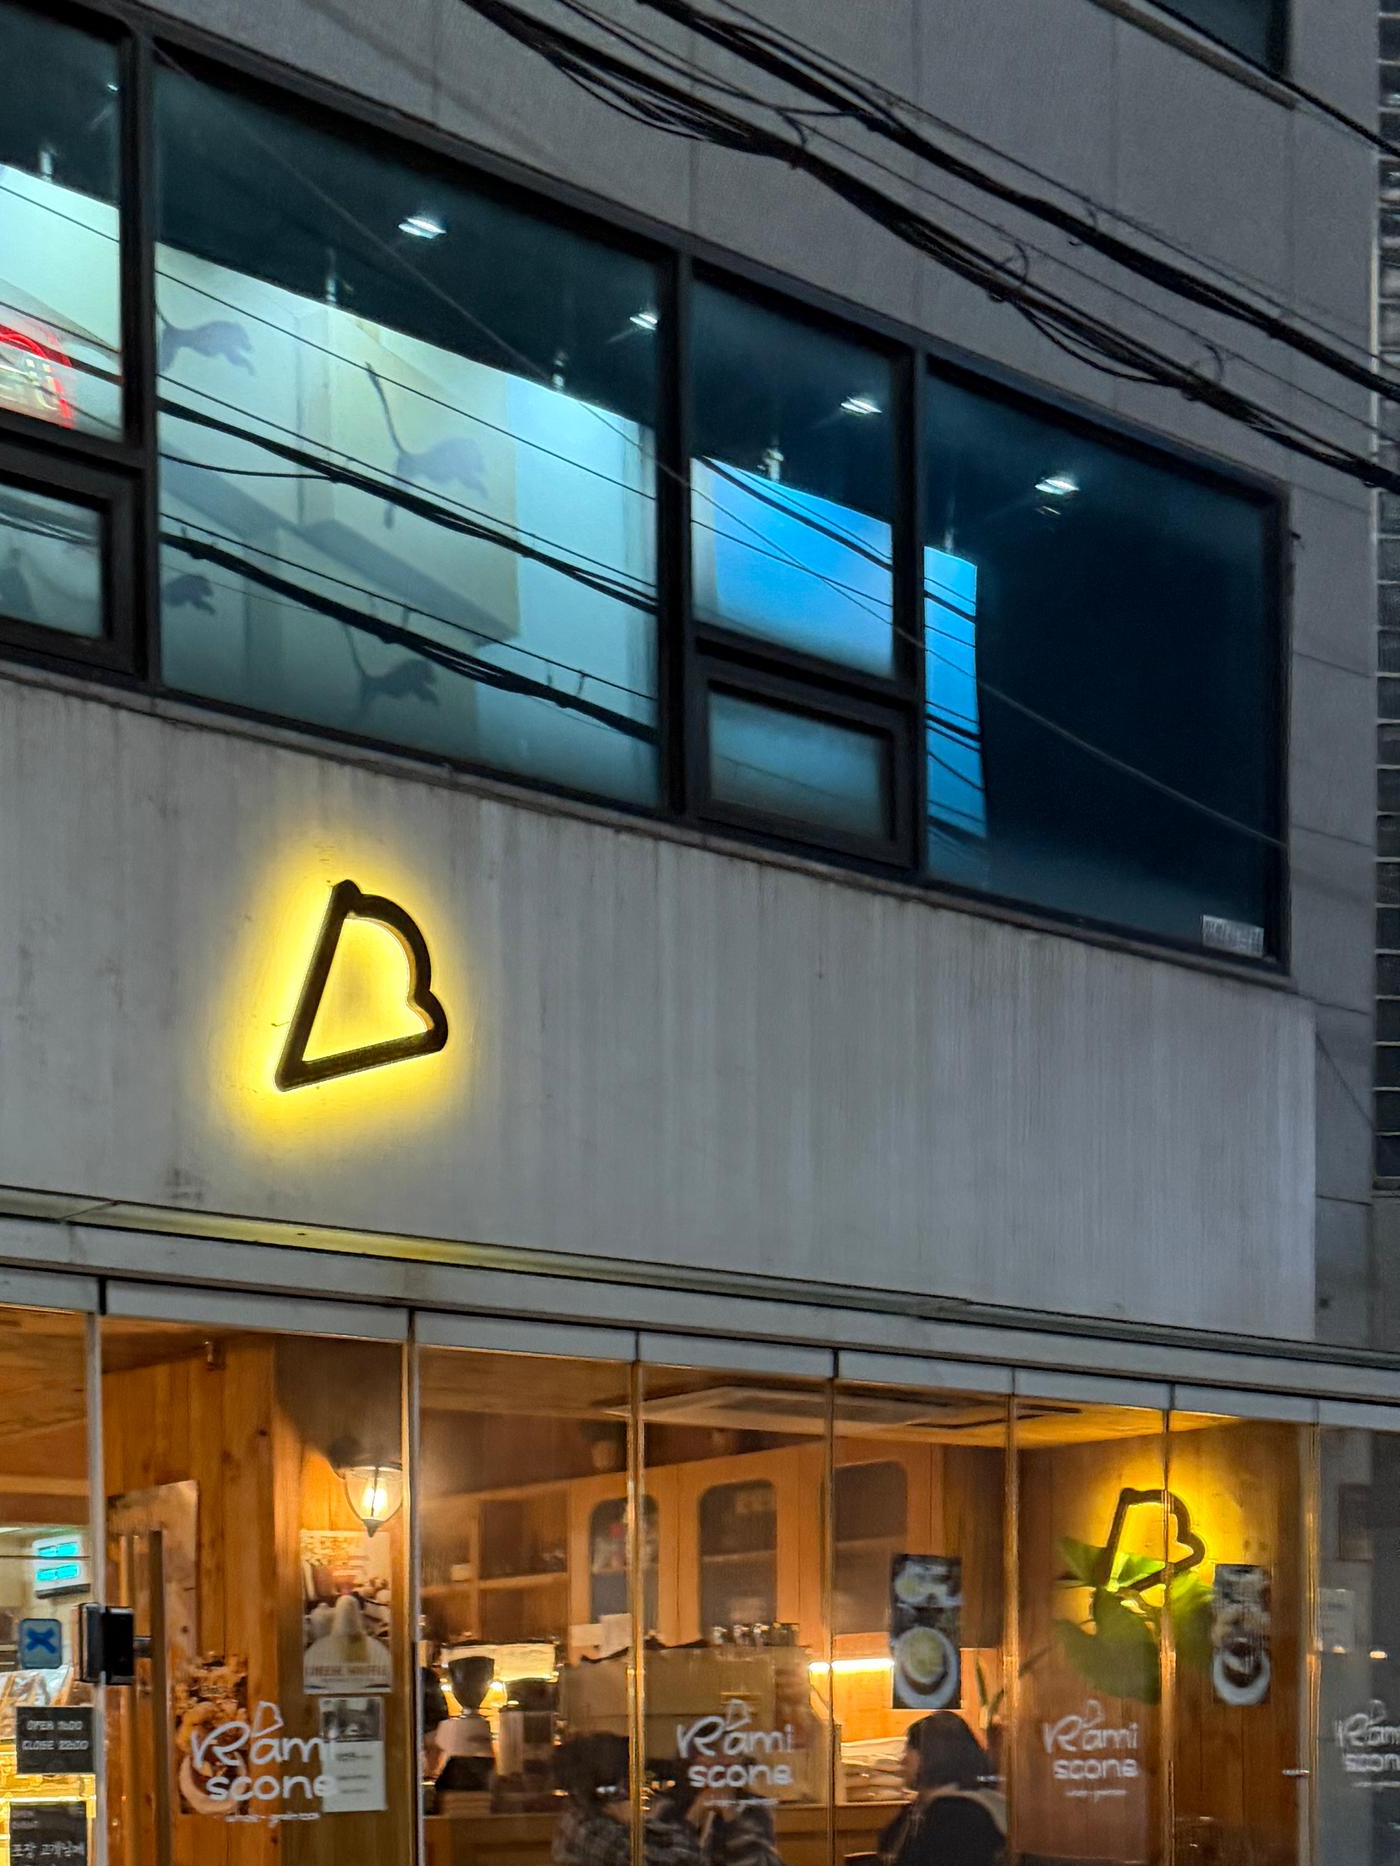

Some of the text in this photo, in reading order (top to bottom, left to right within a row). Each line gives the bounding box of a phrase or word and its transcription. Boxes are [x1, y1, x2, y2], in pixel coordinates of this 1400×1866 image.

[676, 1715, 793, 1758] Rami
[1043, 1714, 1139, 1754] Rami
[1335, 1712, 1400, 1748] Ram
[688, 1764, 793, 1788] scone
[1053, 1758, 1139, 1779] scone
[206, 1774, 336, 1801] scone
